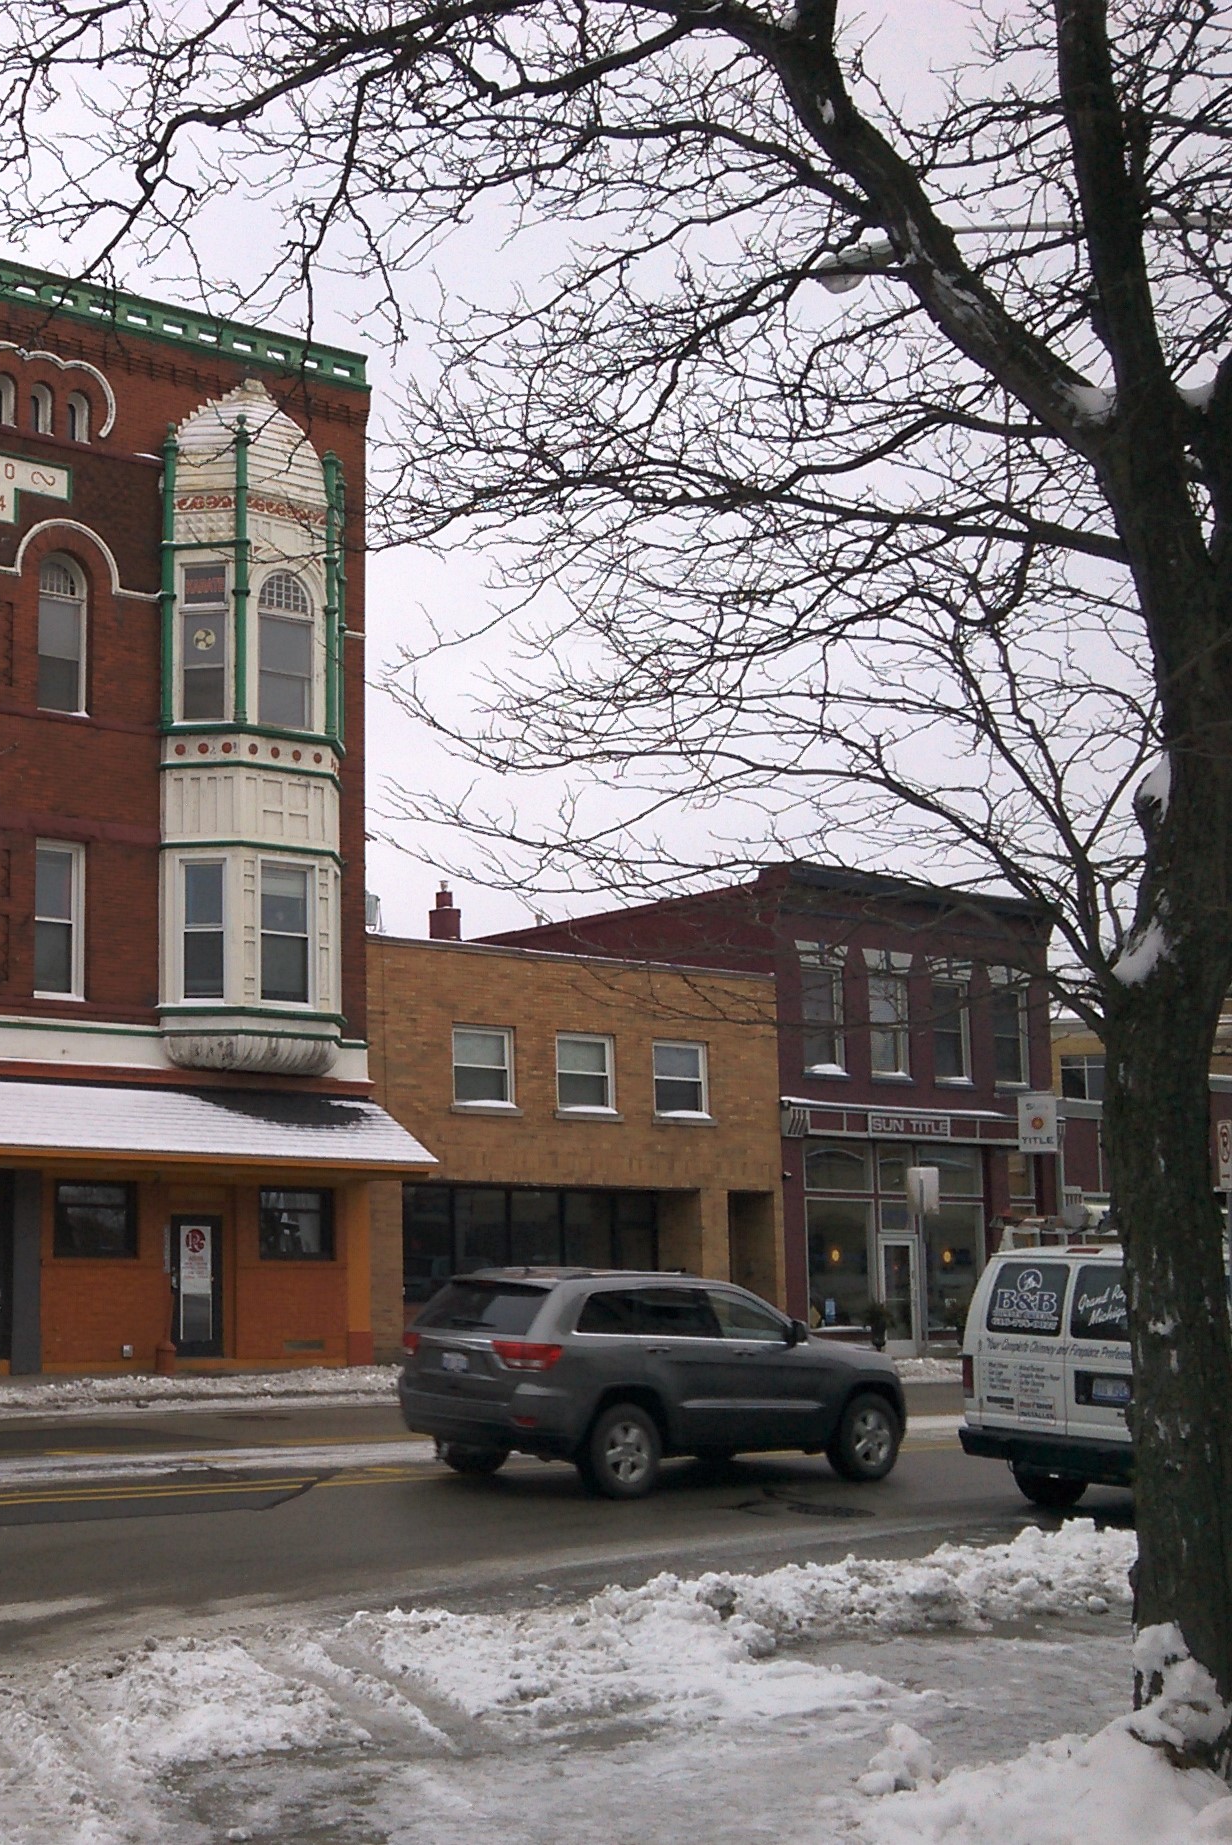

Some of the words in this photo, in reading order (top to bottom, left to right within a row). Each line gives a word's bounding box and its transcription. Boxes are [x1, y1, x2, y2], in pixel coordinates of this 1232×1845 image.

[872, 1118, 905, 1132] SUN
[910, 1120, 948, 1135] TITLE
[1022, 1136, 1055, 1145] TITLE
[997, 1289, 1058, 1313] B&B
[1078, 1286, 1110, 1314] Grand
